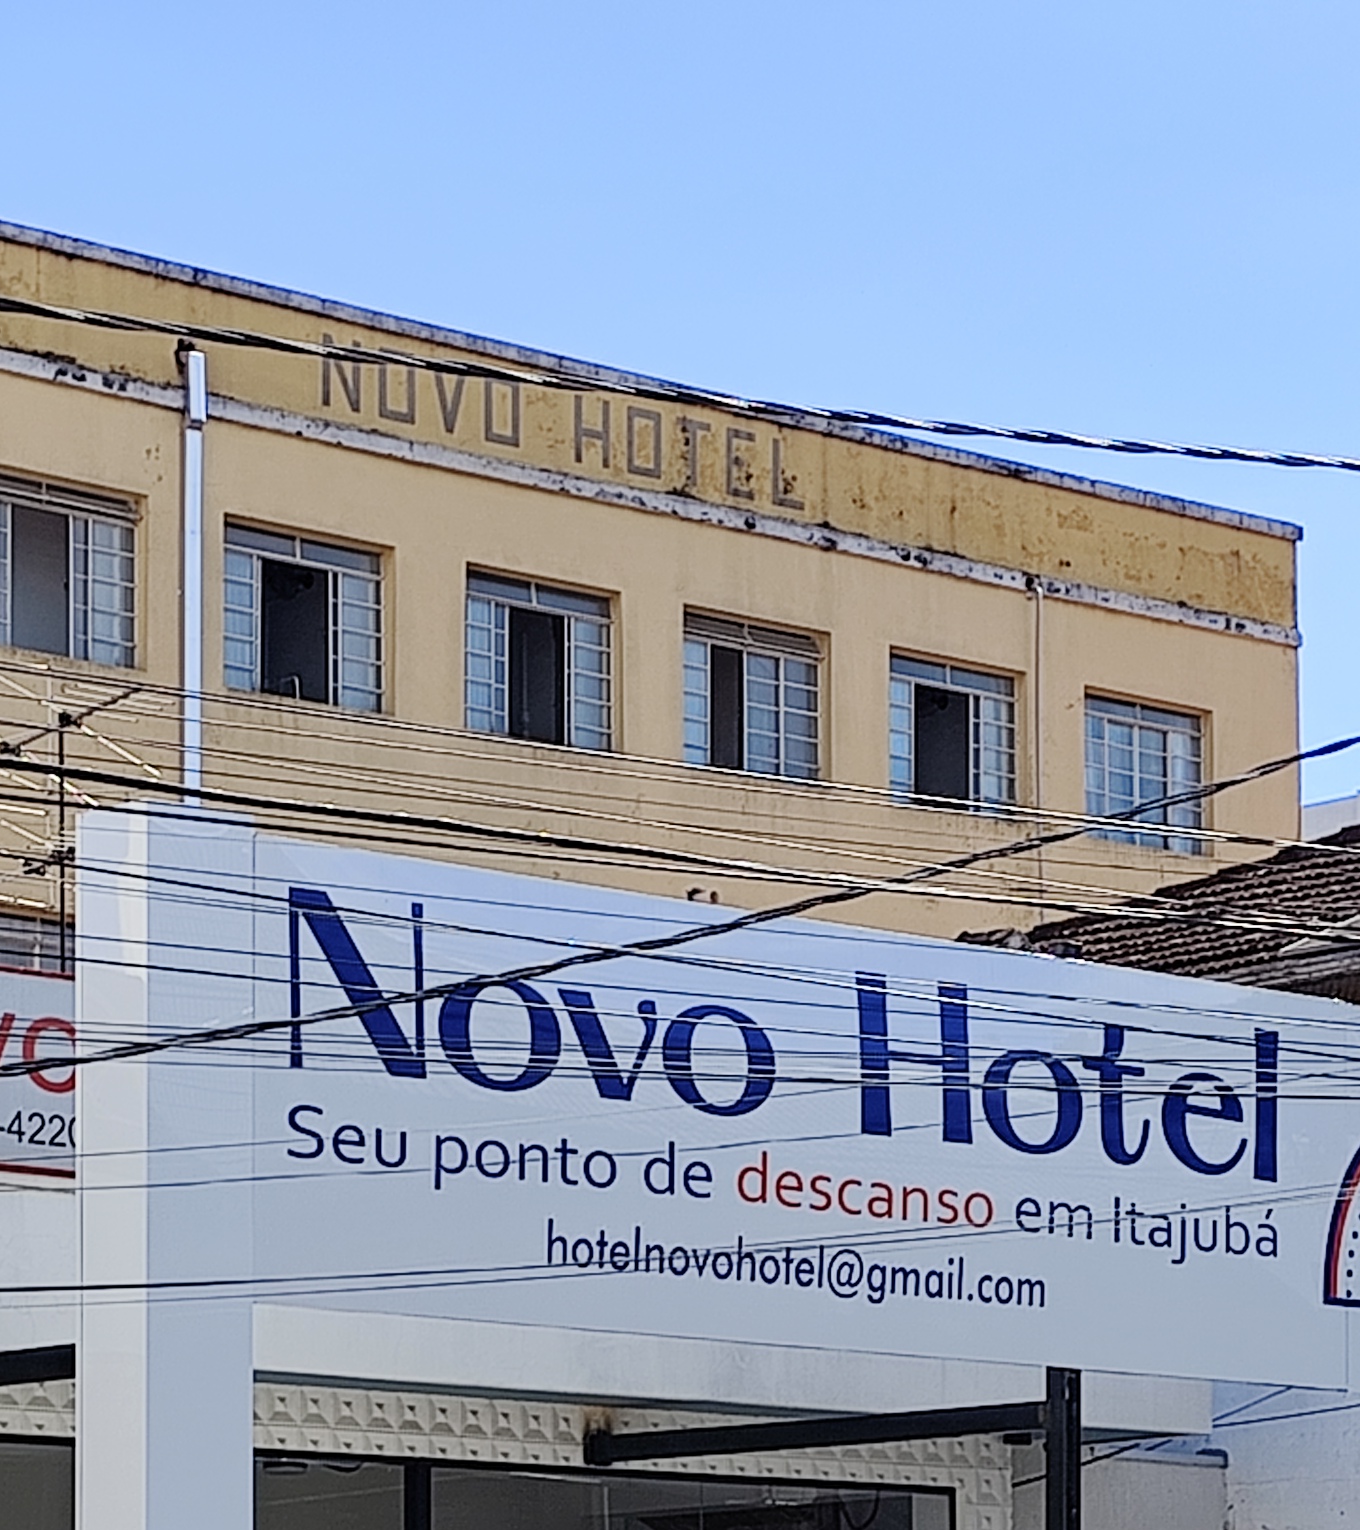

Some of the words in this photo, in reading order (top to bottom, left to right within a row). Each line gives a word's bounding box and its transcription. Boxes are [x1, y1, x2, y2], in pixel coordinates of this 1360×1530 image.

[322, 334, 520, 448] NOVO
[573, 393, 806, 510] HOTEL
[289, 886, 777, 1116] Novo
[855, 970, 1280, 1182] Hotel
[285, 1103, 408, 1168] Seu
[434, 1129, 616, 1191] ponto
[644, 1142, 713, 1200] de
[736, 1152, 994, 1230] descanso
[1014, 1195, 1093, 1241] em
[1112, 1194, 1280, 1264] Itajubá
[547, 1218, 1046, 1310] hotelnovohotel@gmail.com
